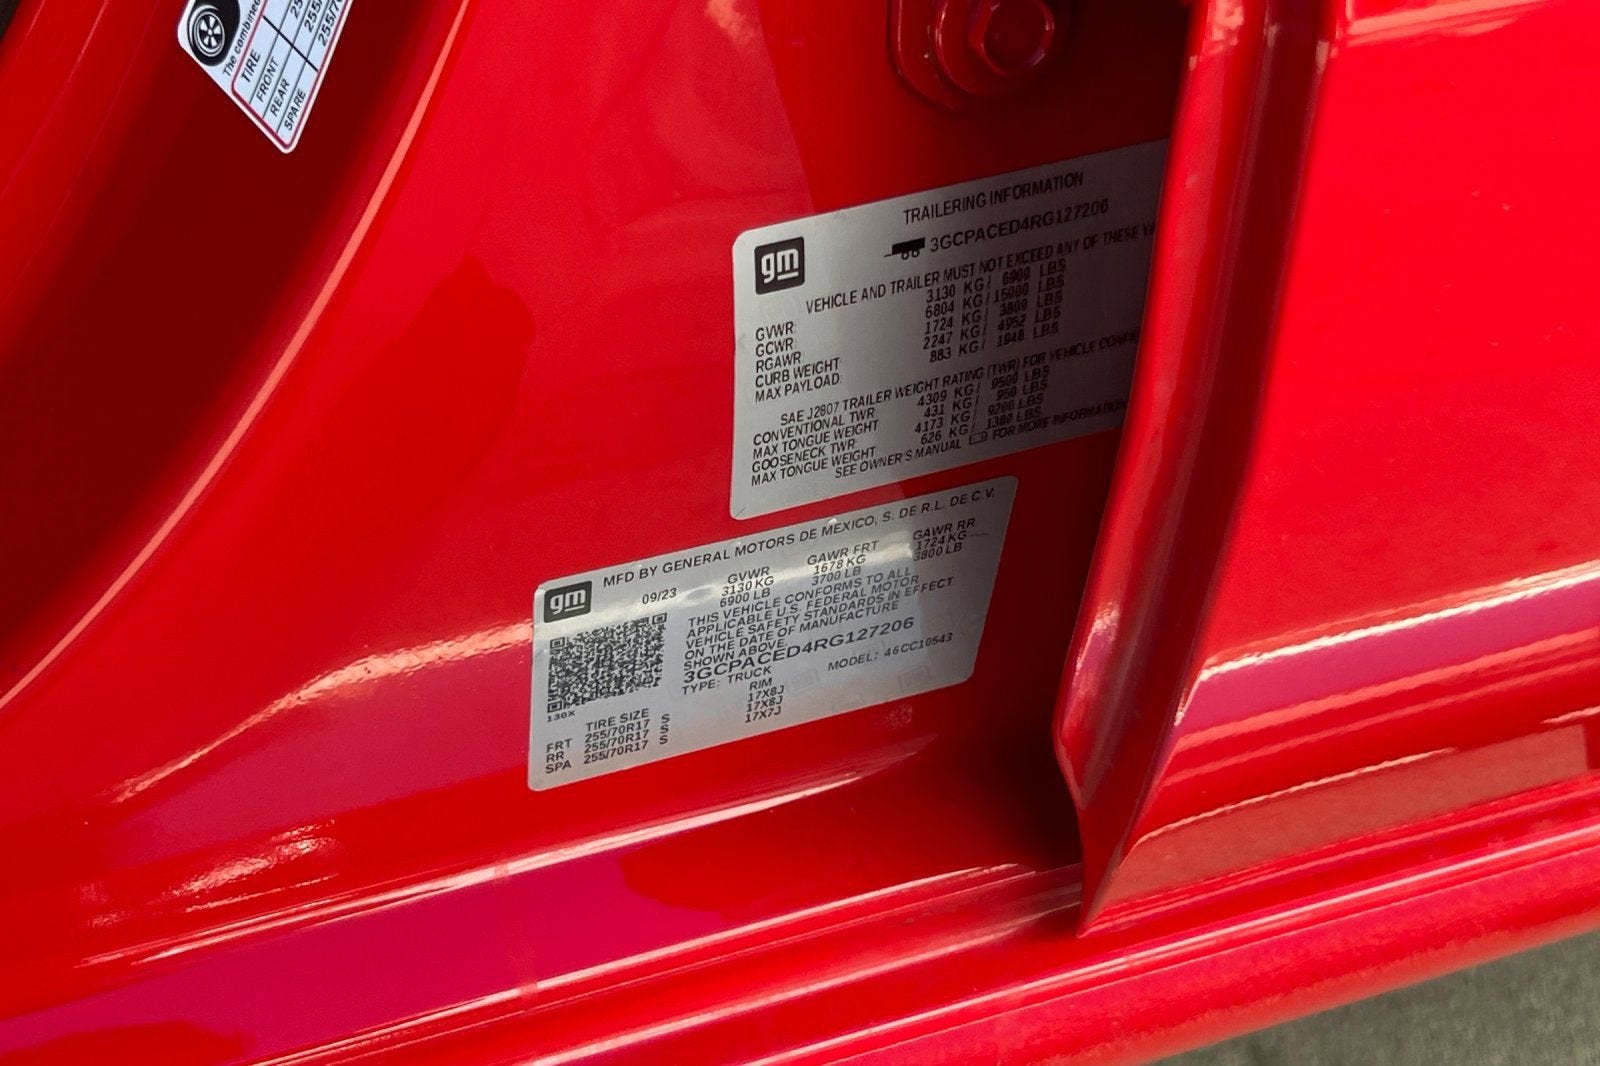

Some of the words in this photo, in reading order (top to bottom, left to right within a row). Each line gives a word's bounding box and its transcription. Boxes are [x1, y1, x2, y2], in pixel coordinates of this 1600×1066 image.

[222, 55, 238, 77] The
[240, 49, 262, 84] TIRE
[256, 55, 280, 103] FRONT
[270, 78, 291, 118] REAR
[284, 89, 307, 131] SPARE
[903, 192, 987, 225] TRAILERING
[990, 170, 1084, 206] INFORMATION
[930, 198, 1109, 252] 3GCPACED4RG127206
[760, 248, 799, 284] gm
[806, 289, 859, 315] VEHICLE
[860, 284, 887, 301] AND
[890, 271, 940, 296] TRAILER
[942, 262, 975, 283] MUST
[979, 256, 1004, 273] NOT
[1006, 248, 1054, 271] EXCEED
[1056, 238, 1080, 255] ANY
[1083, 234, 1099, 251] OF
[1103, 225, 1138, 245] THESE
[927, 284, 956, 303] 3130
[1002, 266, 1031, 286] 6900
[1039, 258, 1067, 277] LBS
[924, 315, 954, 335] 1724
[999, 299, 1028, 317] 3800
[1036, 290, 1064, 309] LBS
[925, 299, 955, 319] 6804
[993, 285, 1030, 304] 15000
[1037, 274, 1065, 293] LBS
[755, 368, 790, 388] CURB
[923, 331, 953, 350] 2247
[998, 315, 1027, 332] 4952
[1034, 308, 1062, 324] LBS
[755, 386, 782, 404] MAX
[929, 347, 952, 363] 883
[1032, 322, 1059, 339] LBS
[753, 414, 845, 446] CONVENTIONAL
[917, 391, 947, 407] 4309
[991, 373, 1019, 391] 9500
[1024, 365, 1050, 383] LBS
[780, 409, 805, 426] SAE
[807, 401, 840, 420] J2807
[842, 388, 893, 411] TRAILER
[894, 378, 939, 399] WEIGHT
[942, 366, 984, 388] RATING
[987, 356, 1021, 379] (TWR)
[1023, 351, 1047, 369] FOR
[1050, 342, 1095, 362] VEHICLE
[751, 446, 826, 473] GOOSENECK
[914, 417, 944, 434] 4173
[987, 400, 1016, 418] 9200
[1018, 393, 1044, 411] LBS
[753, 443, 779, 461] MAX
[782, 430, 831, 452] TONGUE
[924, 403, 945, 419] 431
[996, 386, 1017, 402] 950
[1022, 379, 1048, 396] LBS
[751, 469, 777, 487] MAX
[780, 458, 828, 480] TONGUE
[920, 432, 942, 446] 626
[1016, 407, 1042, 423] LBS
[834, 464, 857, 479] SEE
[859, 449, 913, 473] OWNER'S
[915, 439, 962, 459] MANUAL
[992, 422, 1016, 440] FOR
[1018, 416, 1049, 435] MORE
[603, 570, 635, 588] MFD
[638, 565, 656, 580] BY
[662, 550, 730, 574] GENERAL
[735, 530, 796, 556] MOTORS
[799, 527, 818, 543] DE
[821, 515, 878, 538] MEXICO,
[882, 510, 899, 523] S.
[899, 504, 918, 518] DE
[949, 493, 969, 508] DE
[912, 524, 954, 541] GAWR
[955, 517, 976, 531] RR
[916, 535, 946, 551] 1724
[947, 529, 968, 544] KG
[806, 549, 850, 566] GAWR
[852, 540, 880, 555] FRT
[813, 558, 845, 575] 1678
[846, 553, 867, 567] KG
[913, 547, 944, 562] 3800
[945, 542, 963, 556] LB
[641, 587, 678, 605] 09/23
[687, 611, 721, 628] THIS
[723, 598, 781, 622] VEHICLE
[783, 577, 864, 605] CONFORMS
[865, 573, 884, 586] TO
[886, 567, 912, 580] ALL
[721, 581, 752, 597] 3130
[754, 575, 775, 590] KG
[727, 566, 771, 584] GVWR
[811, 570, 843, 586] 3700
[844, 566, 863, 579] LB
[549, 589, 586, 615] gm
[685, 626, 744, 650] VEHICLE
[747, 614, 799, 635] SAFETY
[803, 594, 887, 622] STANDARDS
[887, 588, 901, 600] IN
[904, 576, 955, 597] EFFECT
[686, 610, 773, 639] APPLICABLE
[774, 604, 801, 619] U.S.
[805, 589, 866, 611] FEDERAL
[871, 575, 920, 594] MOTOR
[719, 592, 751, 609] 6900
[753, 587, 772, 601] LB
[683, 617, 914, 684] 3GCPACED4RG127206
[684, 646, 704, 660] ON
[708, 639, 737, 655] THE
[738, 632, 776, 649] DATE
[778, 626, 796, 639] OF
[799, 601, 900, 634] MANUFACTURE
[827, 654, 880, 672] MODEL:
[884, 632, 954, 657] 46CC10543
[683, 652, 735, 672] SHOWN
[738, 639, 788, 660] ABOVE.
[681, 679, 721, 697] TYPE:
[727, 666, 772, 684] TRUCK
[750, 677, 773, 691] RIM
[546, 710, 577, 723] 130X
[546, 737, 573, 753] FRT
[585, 719, 651, 744] 255/70R17
[660, 713, 671, 725] S
[748, 685, 785, 702] 17X8J
[546, 750, 565, 764] RR
[584, 729, 650, 754] 255/70R17
[659, 723, 670, 735] S
[746, 696, 784, 713] 17X8J
[585, 712, 617, 732] TIRE
[619, 708, 650, 723] SIZE
[545, 760, 573, 775] SPA
[583, 740, 649, 765] 255/70R17
[659, 734, 669, 746] S
[745, 706, 783, 724] 17X7J
